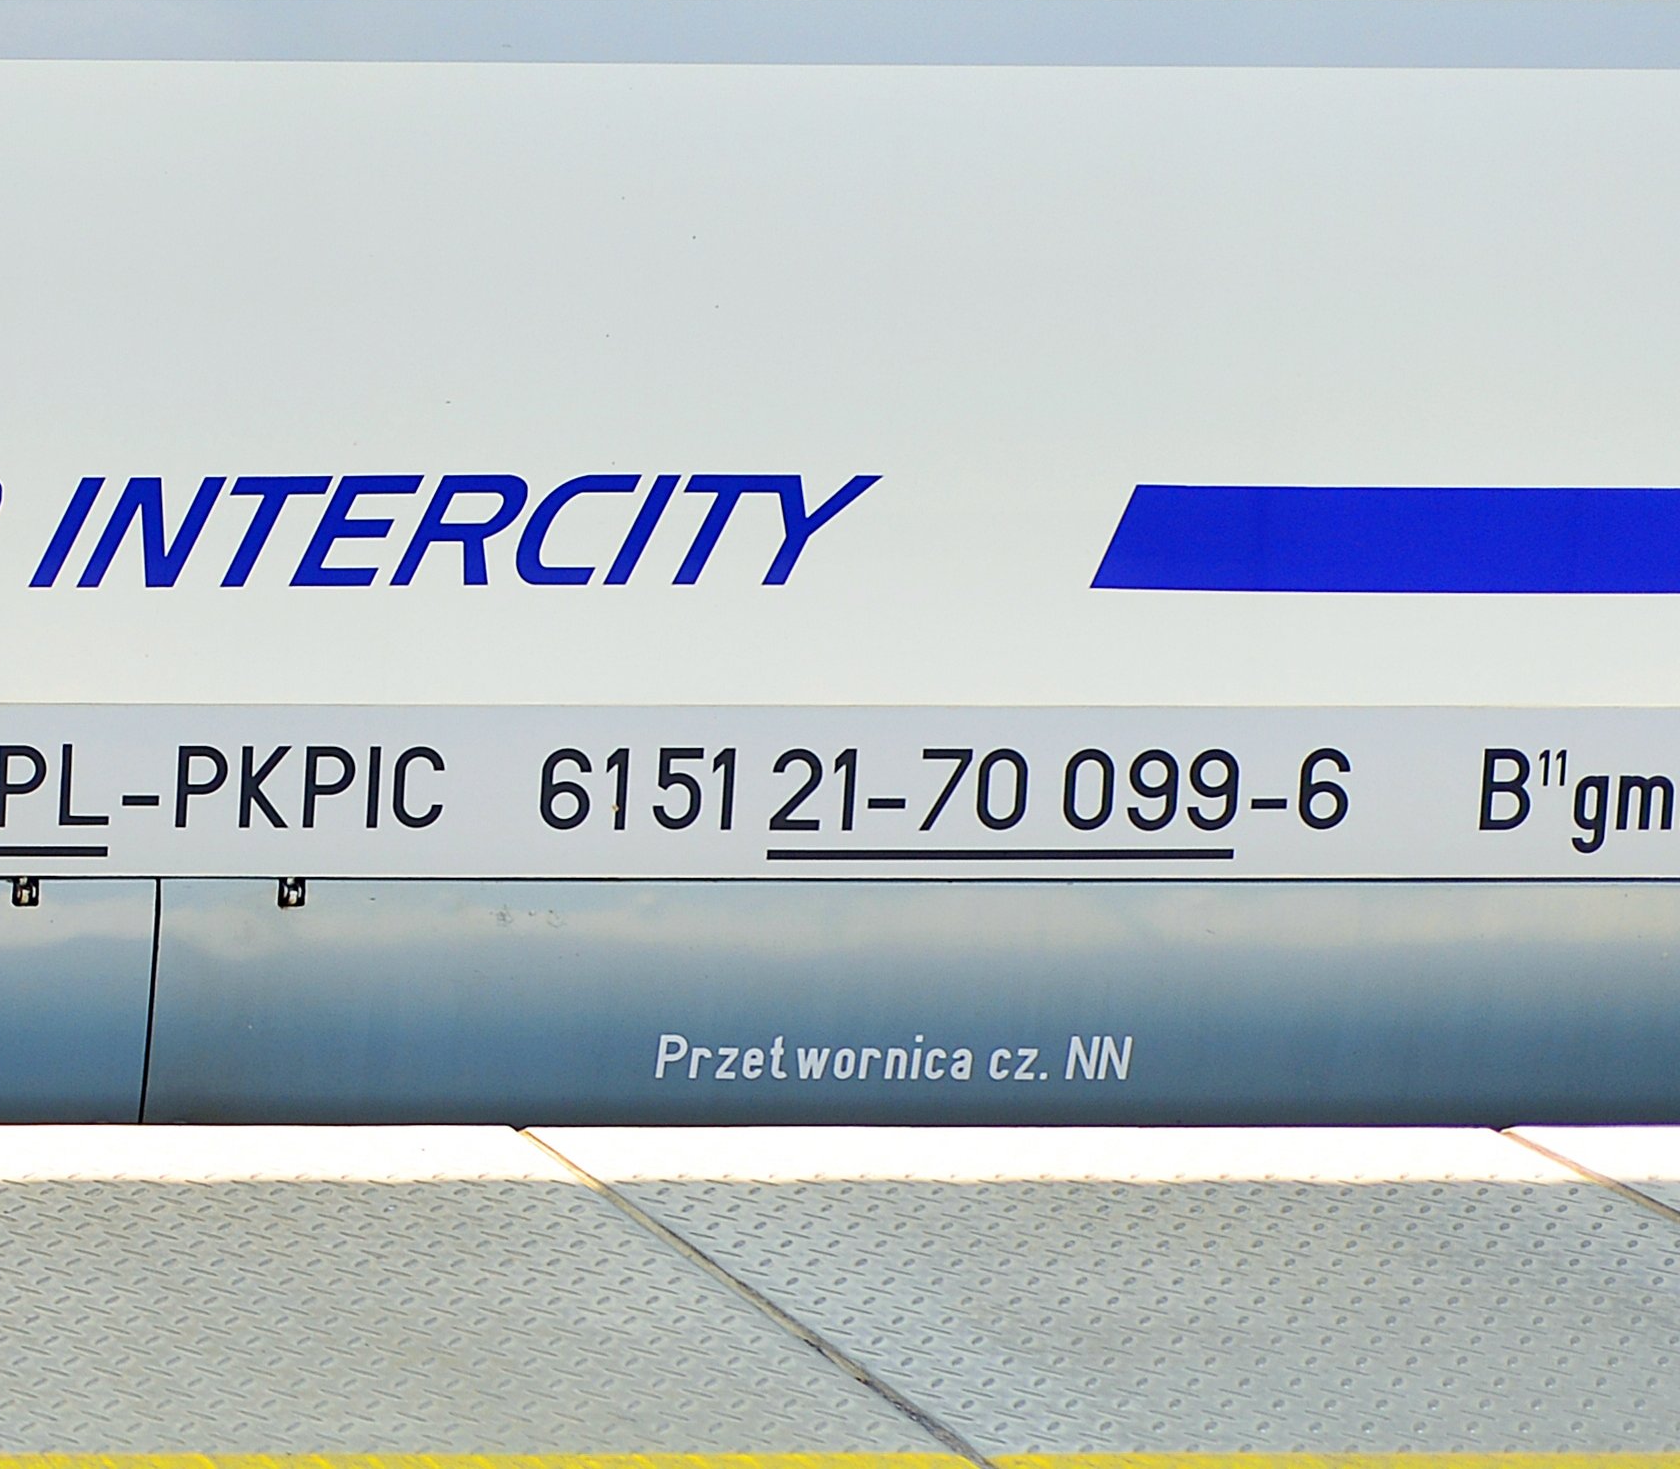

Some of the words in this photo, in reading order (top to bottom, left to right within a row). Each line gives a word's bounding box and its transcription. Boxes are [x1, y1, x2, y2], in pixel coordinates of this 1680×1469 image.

[28, 474, 883, 588] INTERCITY
[768, 748, 1029, 832] 21-70
[1063, 748, 1351, 832] 099-6
[988, 1048, 1048, 1080] cz.
[1065, 1035, 1133, 1080] NN
